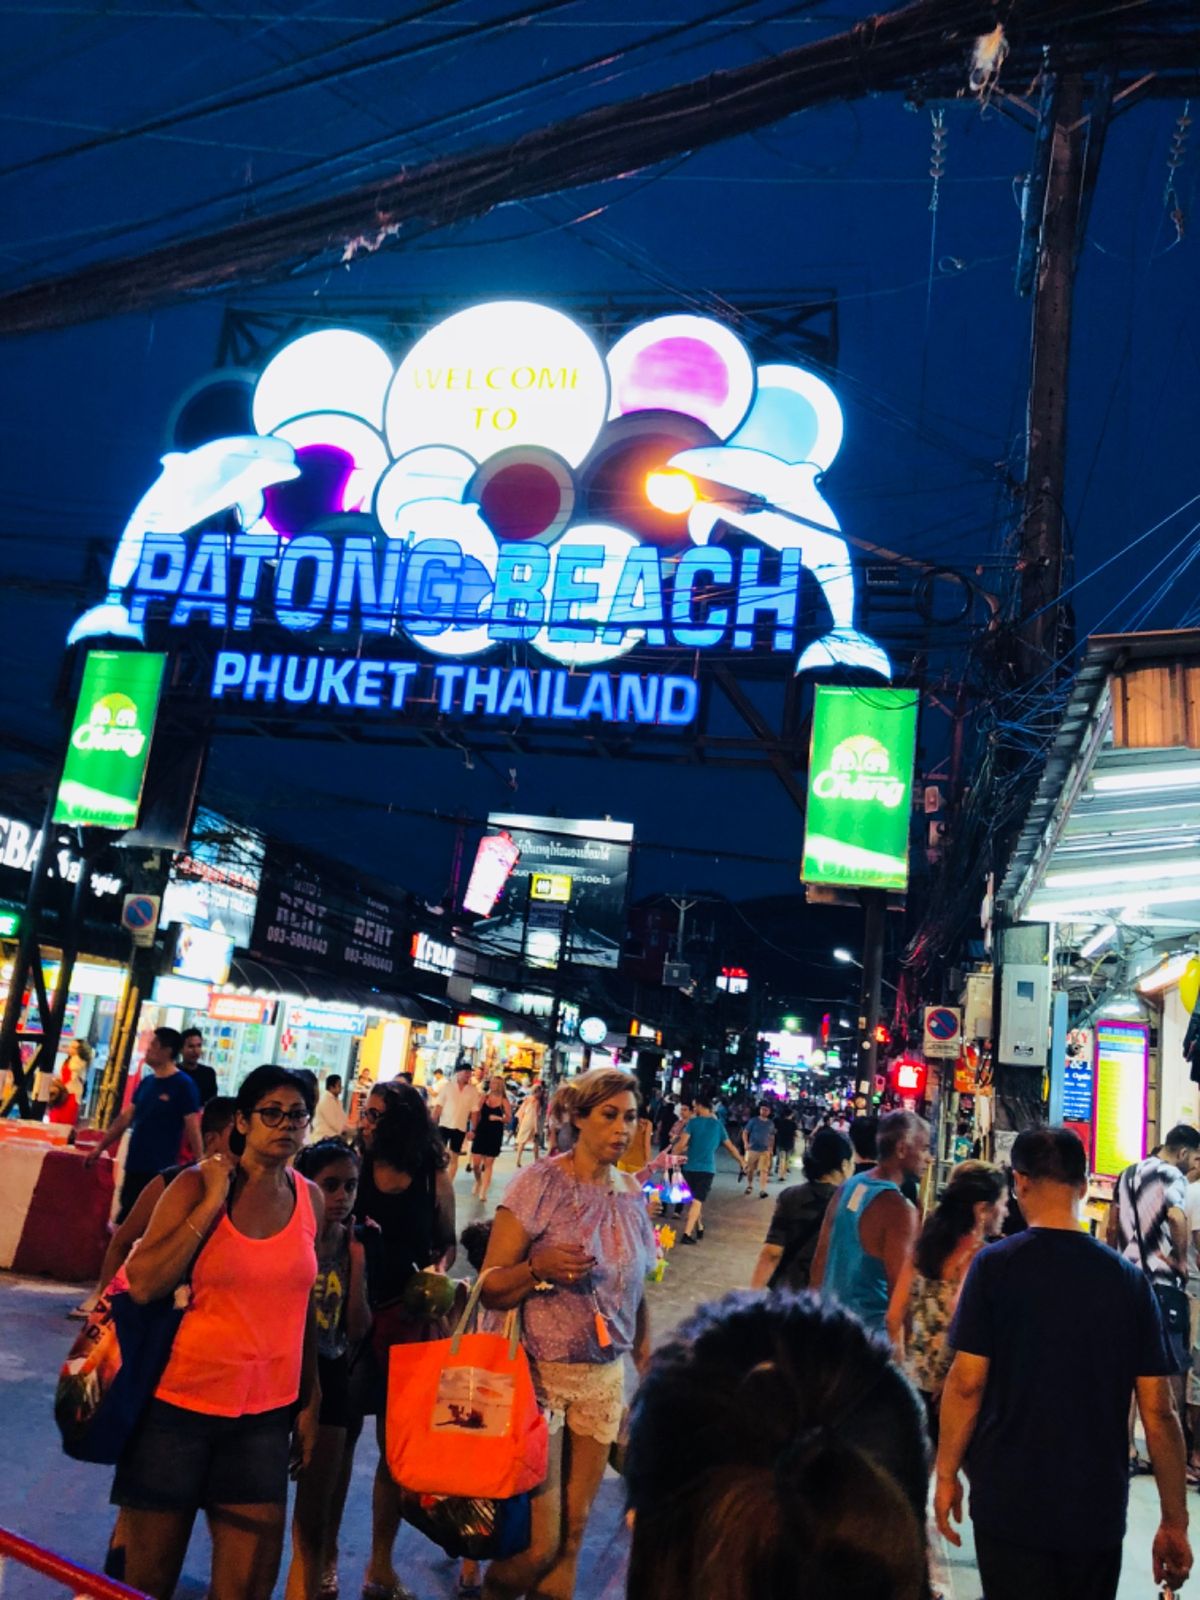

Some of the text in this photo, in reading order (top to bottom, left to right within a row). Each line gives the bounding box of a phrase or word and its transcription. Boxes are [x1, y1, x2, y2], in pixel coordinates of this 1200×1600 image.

[471, 406, 519, 431] TO
[129, 532, 802, 651] PATONG BEACH
[210, 651, 699, 727] PHUKET THAILAND
[812, 770, 905, 809] Chang
